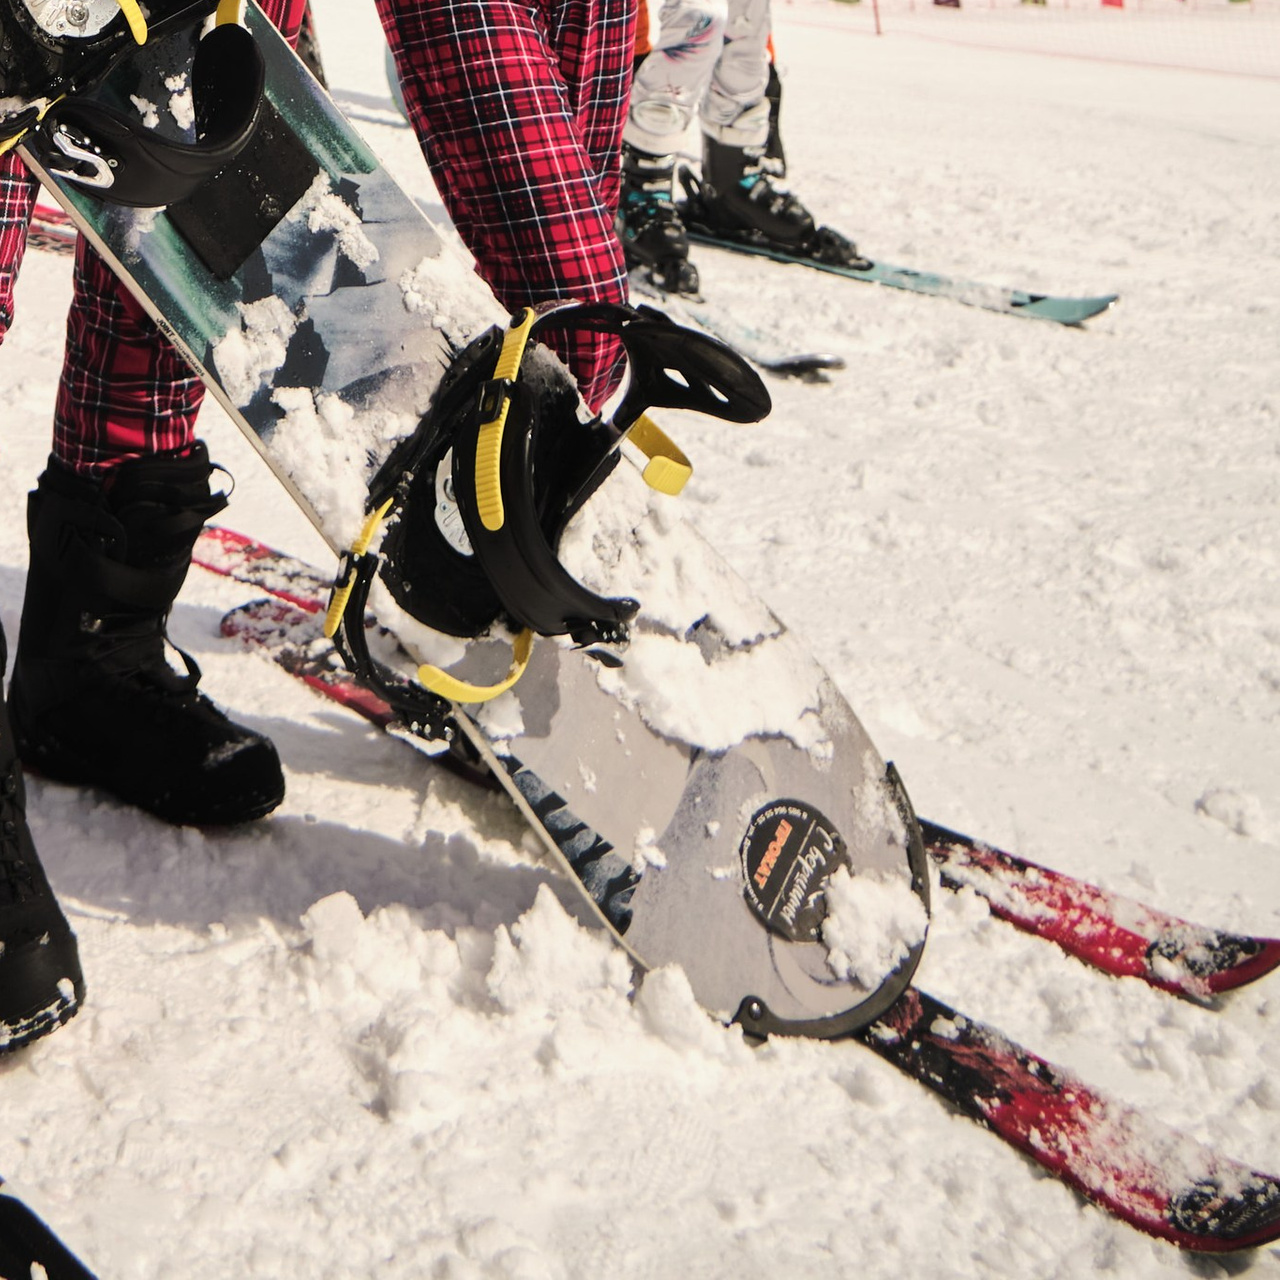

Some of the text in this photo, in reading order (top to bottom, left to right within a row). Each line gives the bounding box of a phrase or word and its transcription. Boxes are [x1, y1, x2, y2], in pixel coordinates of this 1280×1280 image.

[156, 318, 175, 337] JOINT
[754, 819, 793, 890] ПРОКАТ
[780, 846, 826, 926] вершины
